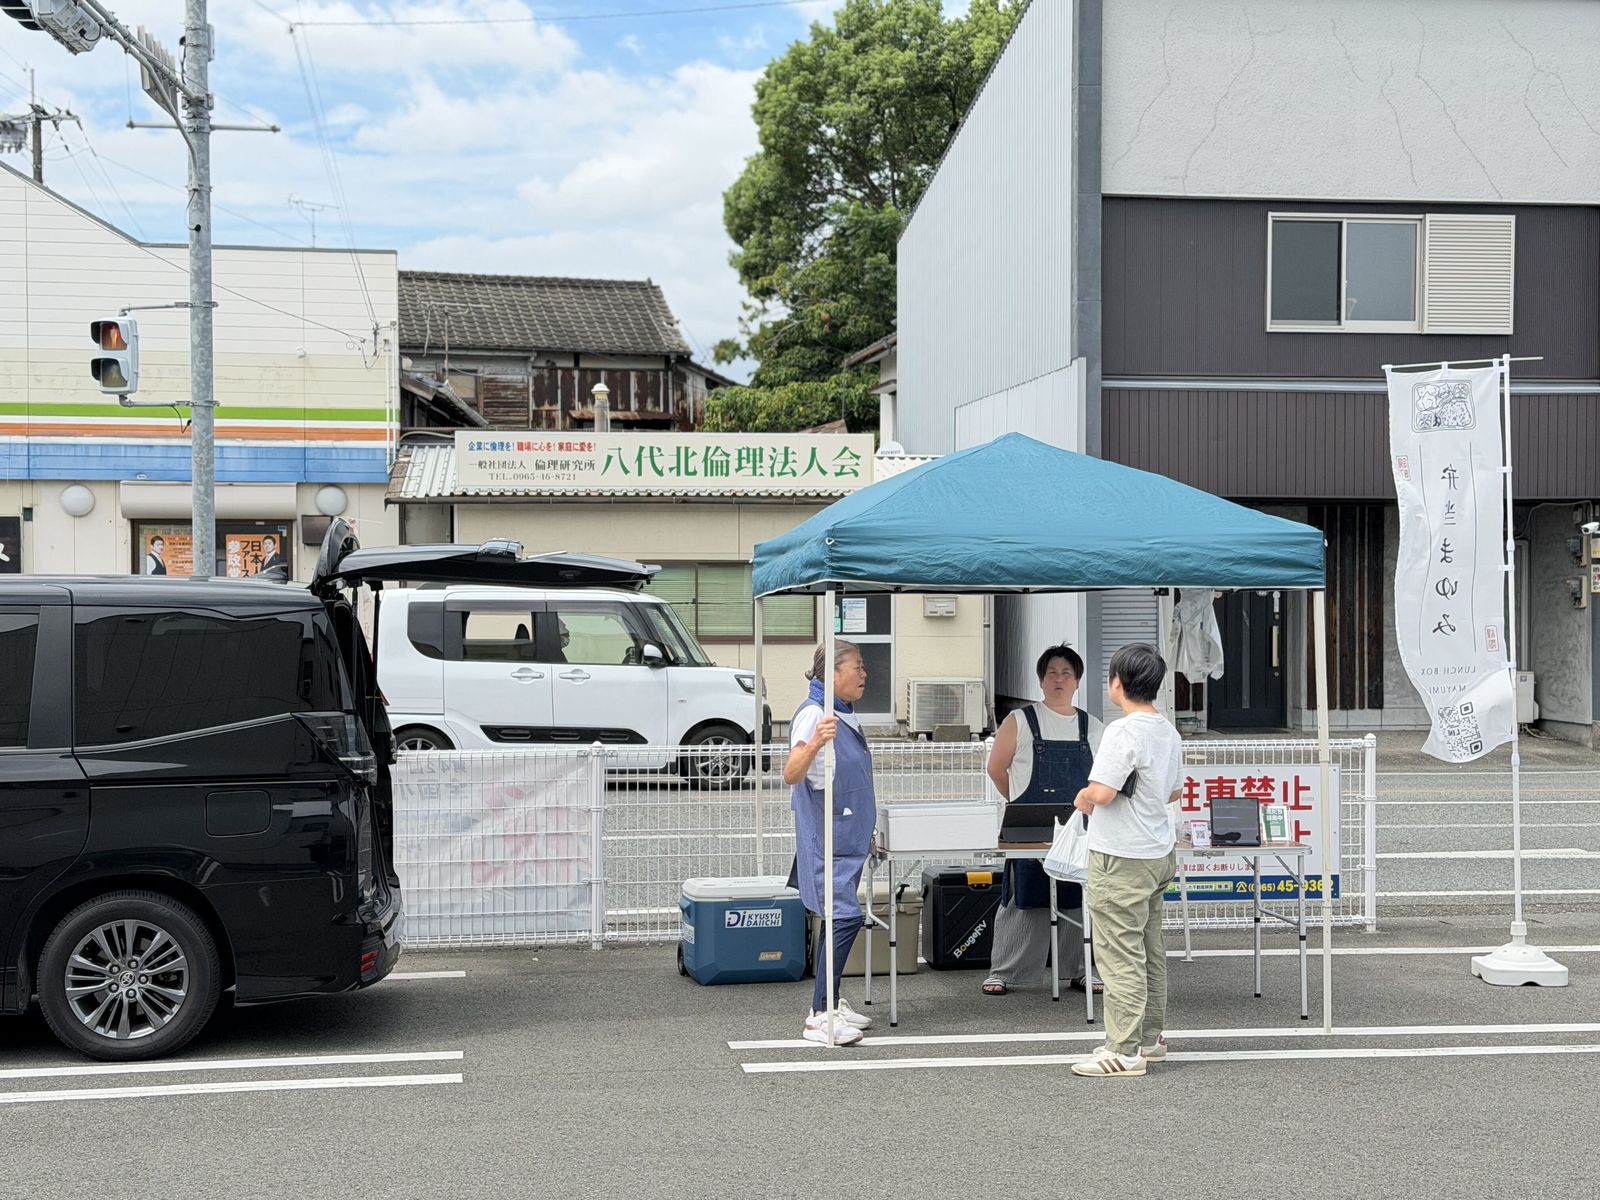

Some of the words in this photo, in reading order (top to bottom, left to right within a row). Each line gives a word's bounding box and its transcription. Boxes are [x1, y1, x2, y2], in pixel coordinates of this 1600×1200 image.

[468, 460, 527, 470] 一般社団法人
[534, 459, 595, 471] 倫理研究所
[600, 445, 862, 478] 八代北倫理法人会
[748, 912, 781, 921] KYUSYU
[747, 919, 780, 928] DAIICHI
[953, 920, 987, 959] BougeRV
